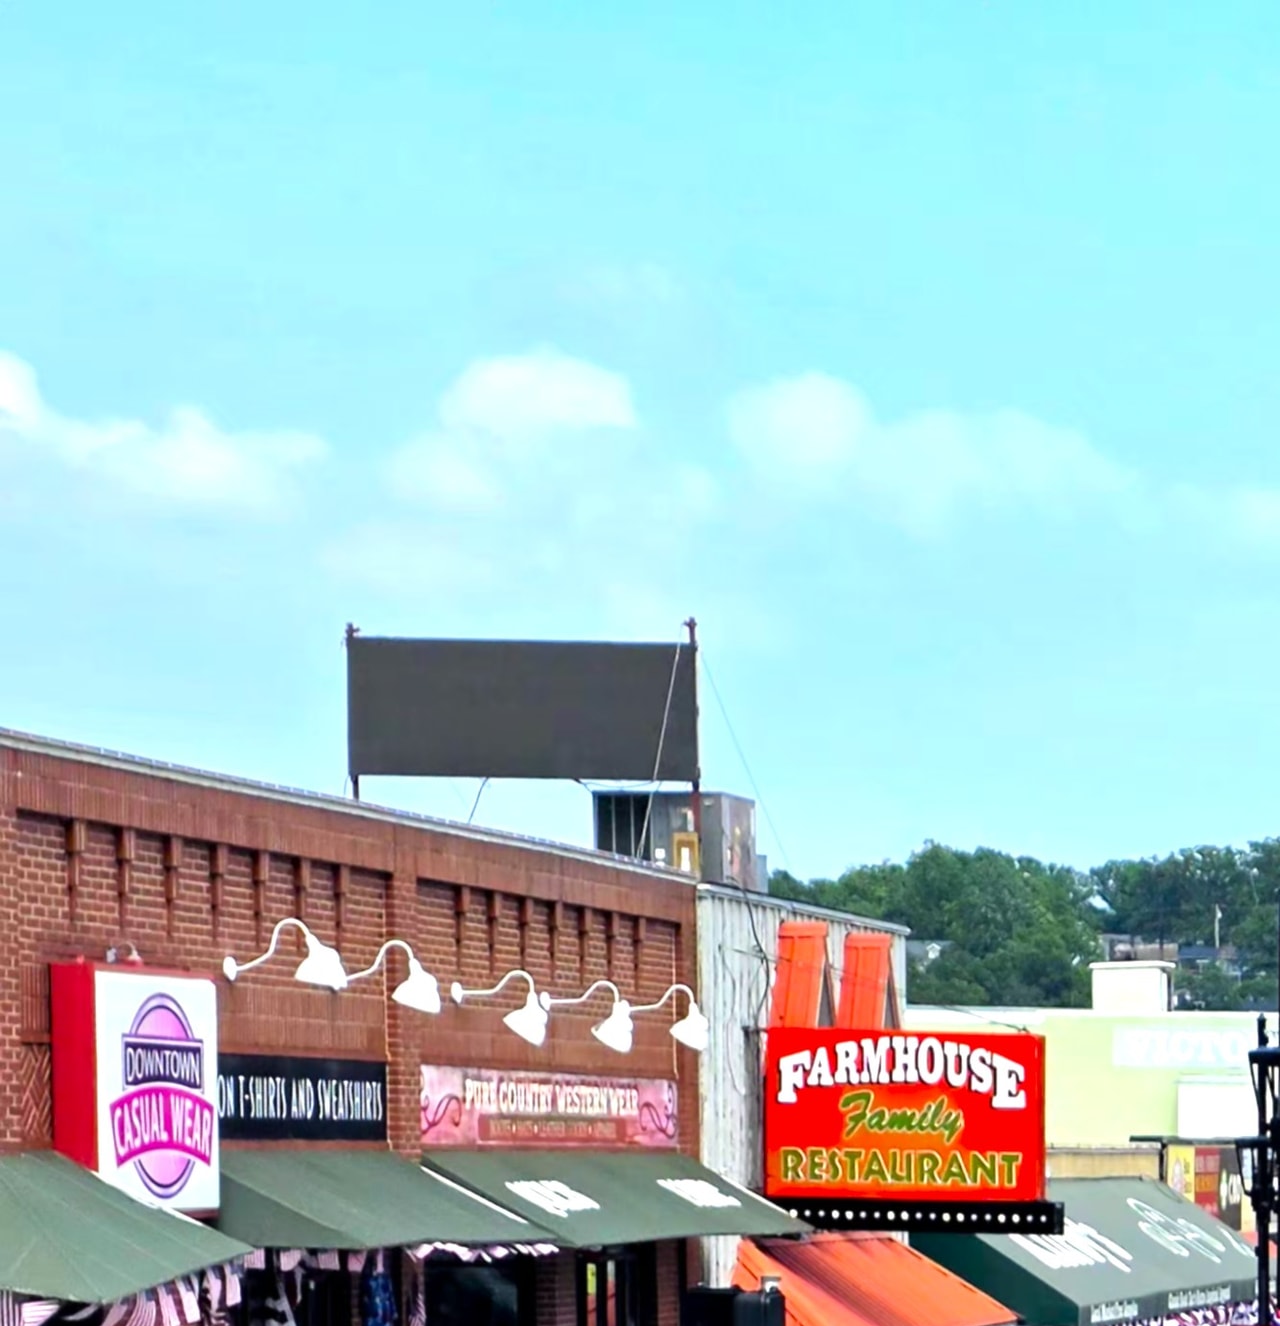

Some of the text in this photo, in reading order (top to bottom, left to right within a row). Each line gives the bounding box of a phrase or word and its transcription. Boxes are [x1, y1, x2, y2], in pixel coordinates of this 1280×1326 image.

[126, 1047, 200, 1083] DOWNTOWN
[777, 1036, 1026, 1109] FARMHOUSE
[238, 1076, 287, 1119] T-SHIRTS
[291, 1077, 314, 1120] AND
[318, 1079, 383, 1121] SWEATSHIRTS
[499, 1083, 552, 1114] COUNTRY
[838, 1090, 965, 1144] Family
[112, 1092, 211, 1158] CASUAL WEAR
[781, 1147, 1022, 1189] RESTAURANT
